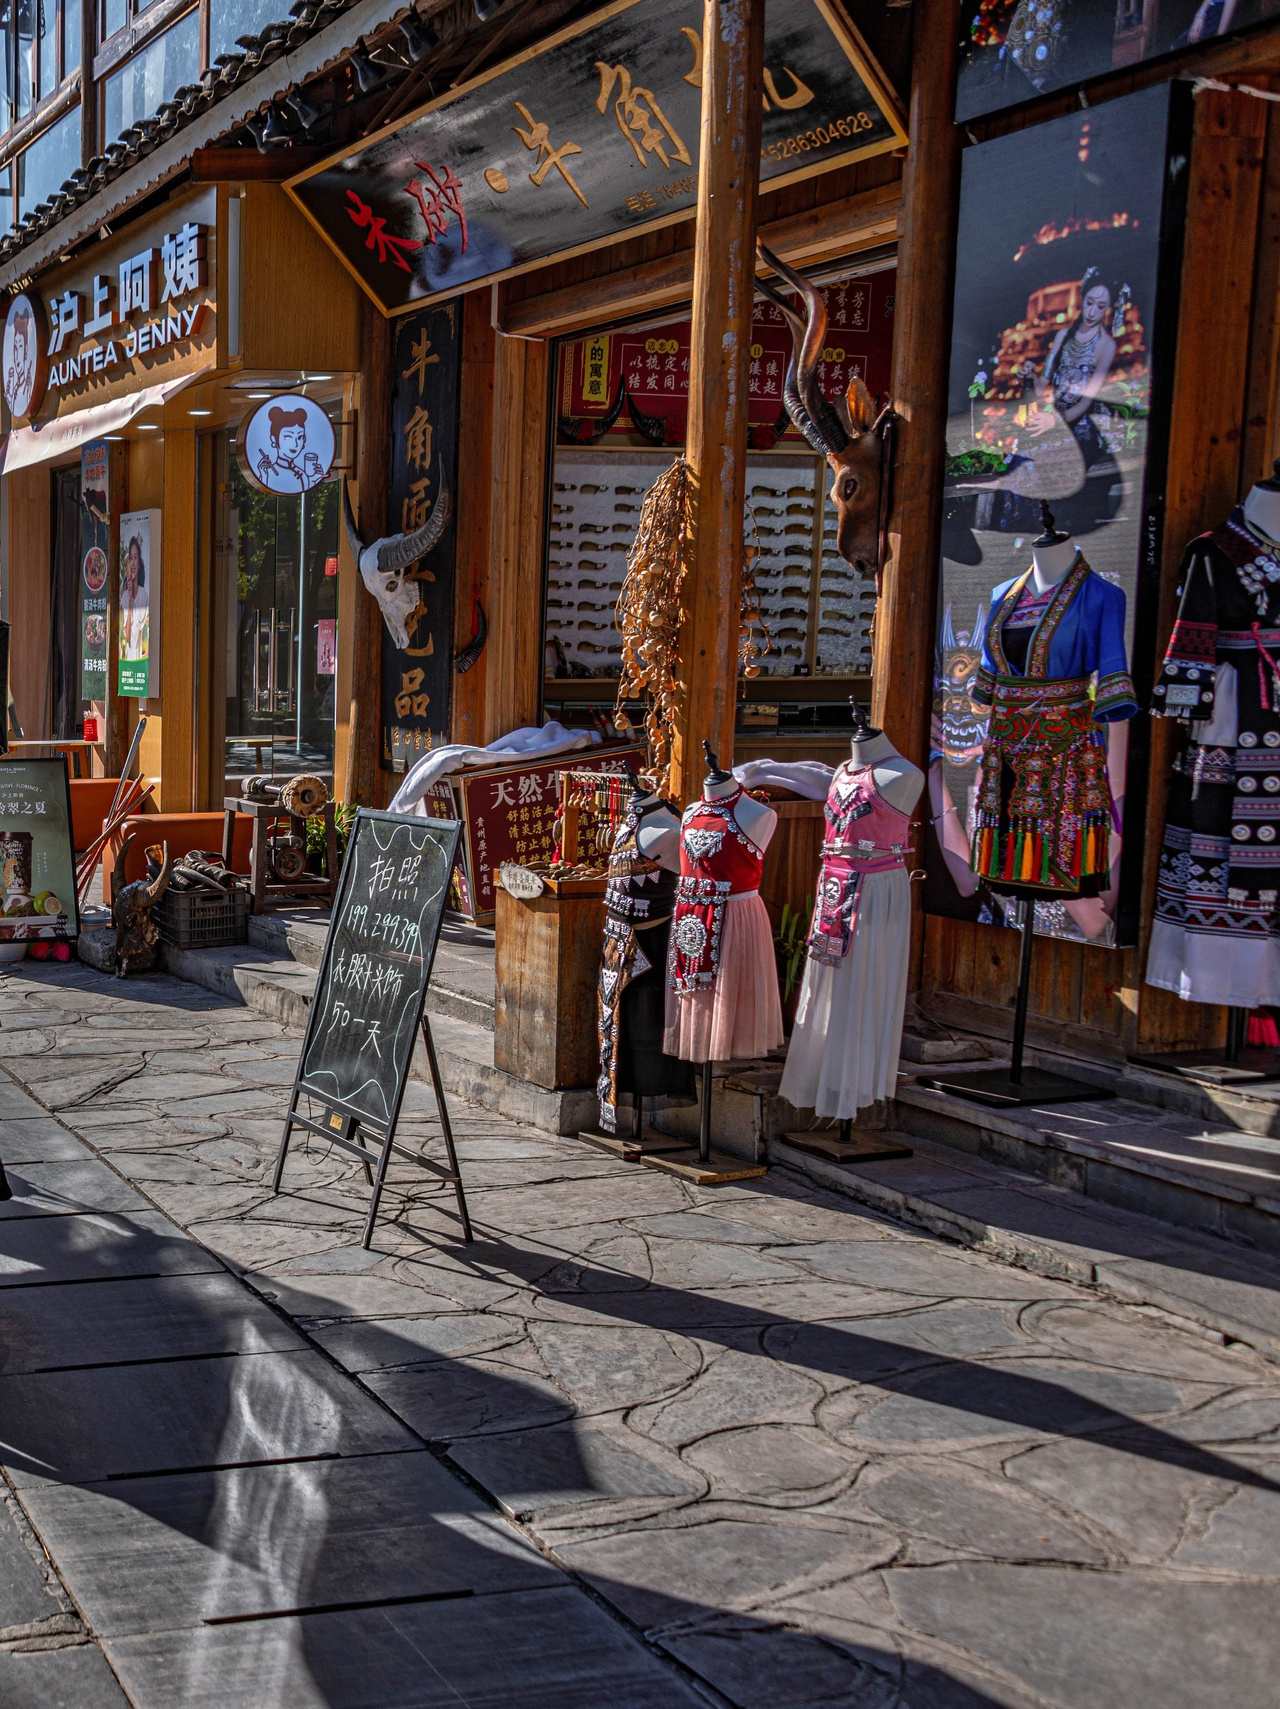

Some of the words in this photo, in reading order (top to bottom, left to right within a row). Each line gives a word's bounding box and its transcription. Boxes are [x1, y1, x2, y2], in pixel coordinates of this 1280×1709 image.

[760, 111, 875, 163] 15286304628
[47, 222, 204, 357] 沪上阿姨
[47, 340, 119, 391] AUNTEA
[124, 303, 204, 357] JENNY
[646, 340, 677, 353] 送恋人
[490, 760, 624, 810] 天然牛
[475, 816, 491, 896] 贵州原产地直销
[516, 835, 563, 853] 防止静
[368, 854, 422, 902] 拍照
